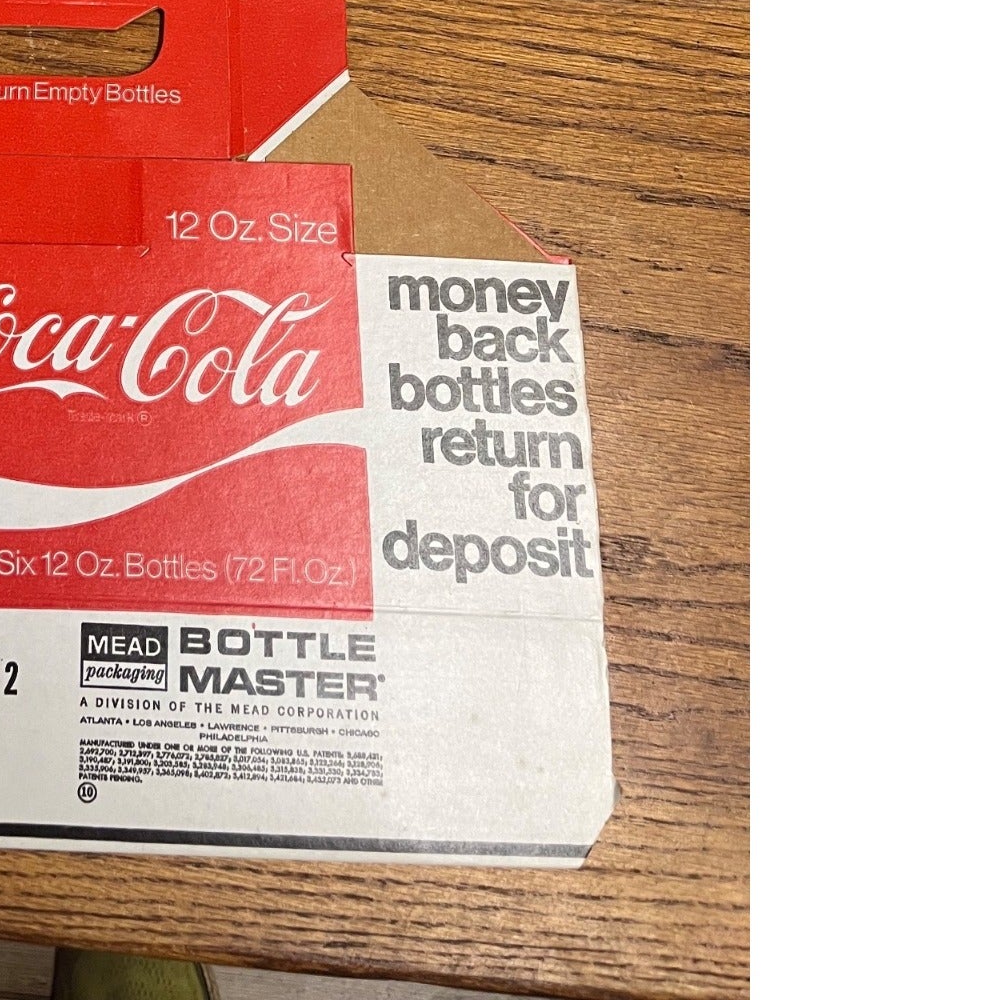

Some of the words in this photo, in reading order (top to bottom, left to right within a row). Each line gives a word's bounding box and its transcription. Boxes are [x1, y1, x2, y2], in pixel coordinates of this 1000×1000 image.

[34, 82, 101, 104] Empty
[106, 84, 181, 104] Bottles
[166, 211, 200, 239] 12
[210, 211, 262, 242] Oz.
[269, 213, 338, 244] Size
[388, 275, 569, 322] money
[436, 313, 574, 363] back
[389, 363, 578, 416] bottles
[421, 419, 583, 469] return
[508, 471, 586, 521] for
[41, 552, 68, 576] 12
[76, 551, 119, 578] Oz.
[126, 552, 216, 581] Bottles
[224, 554, 265, 583] (72
[382, 519, 594, 584] deposit
[88, 635, 161, 657] MEAD
[180, 627, 376, 662] BOTTLE
[4, 661, 18, 695] 2
[86, 665, 164, 684] packaging
[80, 697, 87, 707] A
[96, 698, 160, 710] DIVISION
[170, 701, 186, 712] OF
[195, 703, 222, 714] THE
[231, 704, 269, 715] MEAD
[278, 706, 379, 721] CORPORATION
[80, 716, 122, 725] ATLANTA
[154, 720, 196, 729] ANGELES
[208, 723, 260, 731] LAWRENCE
[271, 726, 328, 734] PITTSBURGH
[339, 729, 379, 737] CHICAGO
[200, 733, 268, 742] PHILADELPHIA
[80, 739, 134, 748] MANUFACTURED
[197, 744, 217, 752] MORE
[235, 746, 247, 754] THE
[251, 748, 292, 756] FOLLOWING
